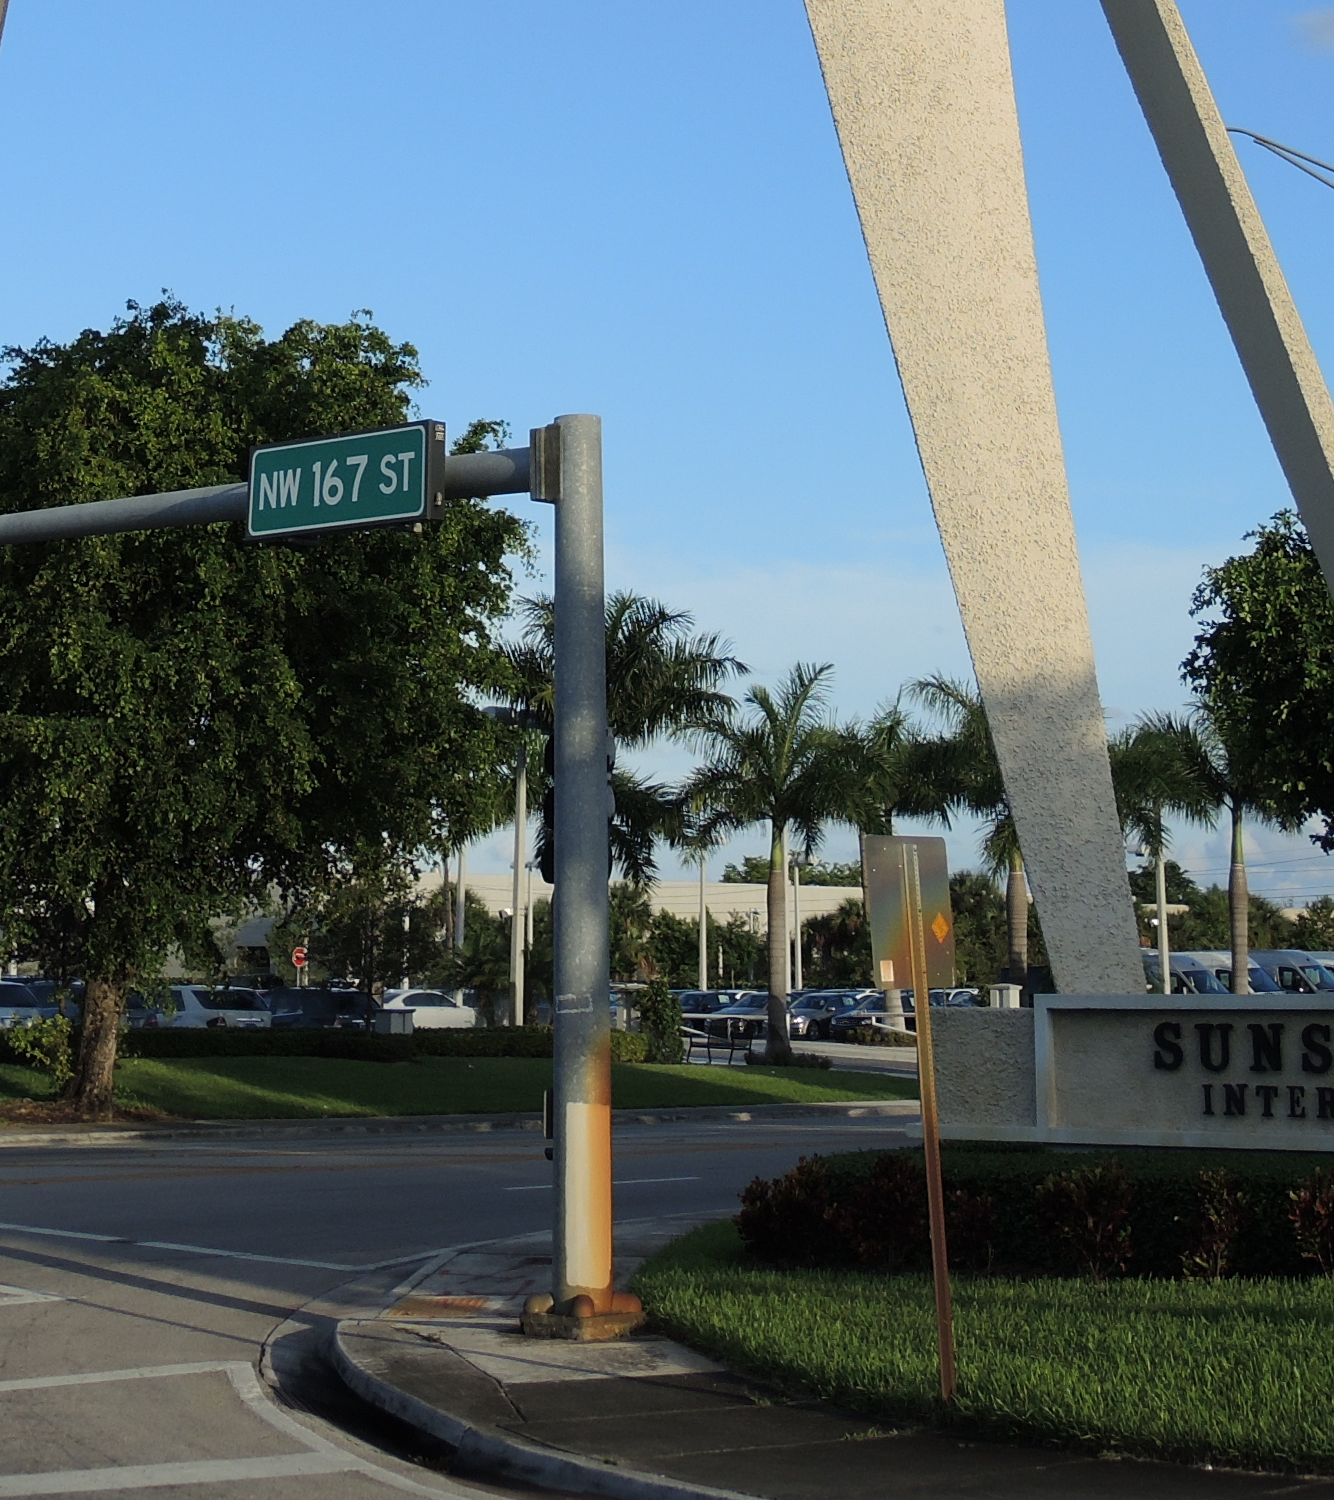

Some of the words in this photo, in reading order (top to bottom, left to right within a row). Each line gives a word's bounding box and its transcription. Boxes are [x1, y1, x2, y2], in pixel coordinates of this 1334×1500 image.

[258, 467, 301, 511] NW
[312, 454, 368, 507] 167
[379, 451, 415, 495] ST
